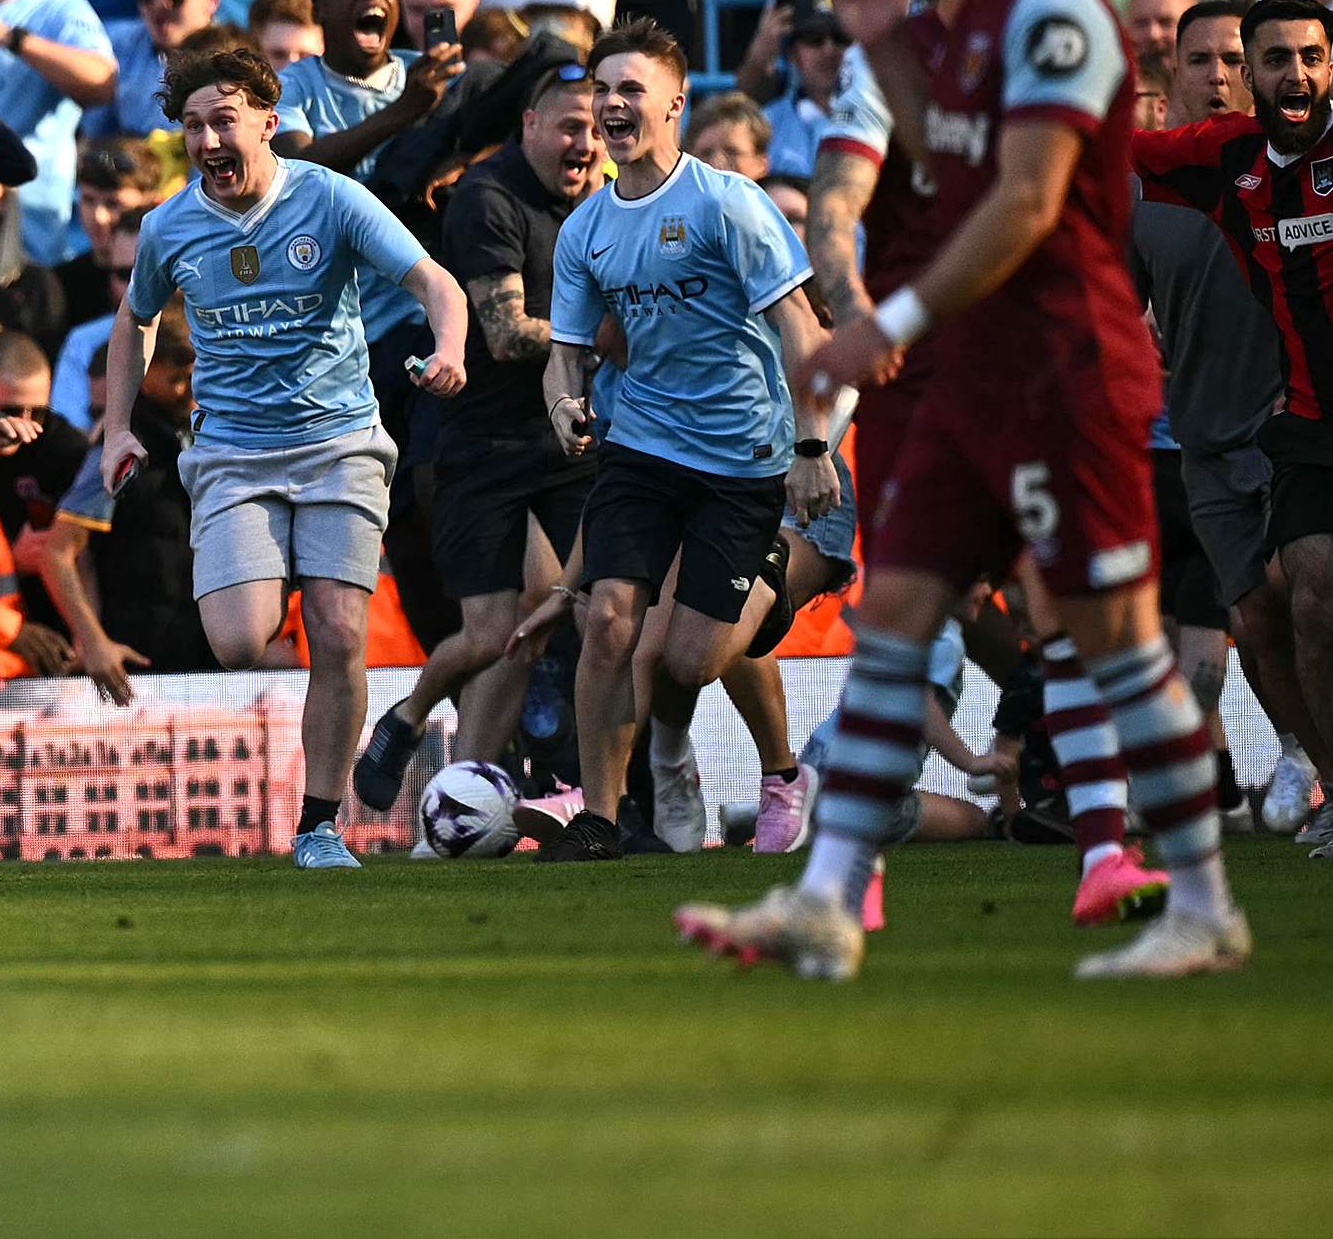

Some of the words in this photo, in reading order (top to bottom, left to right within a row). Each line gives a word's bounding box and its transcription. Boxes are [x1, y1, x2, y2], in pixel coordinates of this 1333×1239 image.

[1285, 220, 1332, 240] ADVICE
[196, 293, 323, 325] ETIHAD
[1013, 464, 1059, 540] 5
